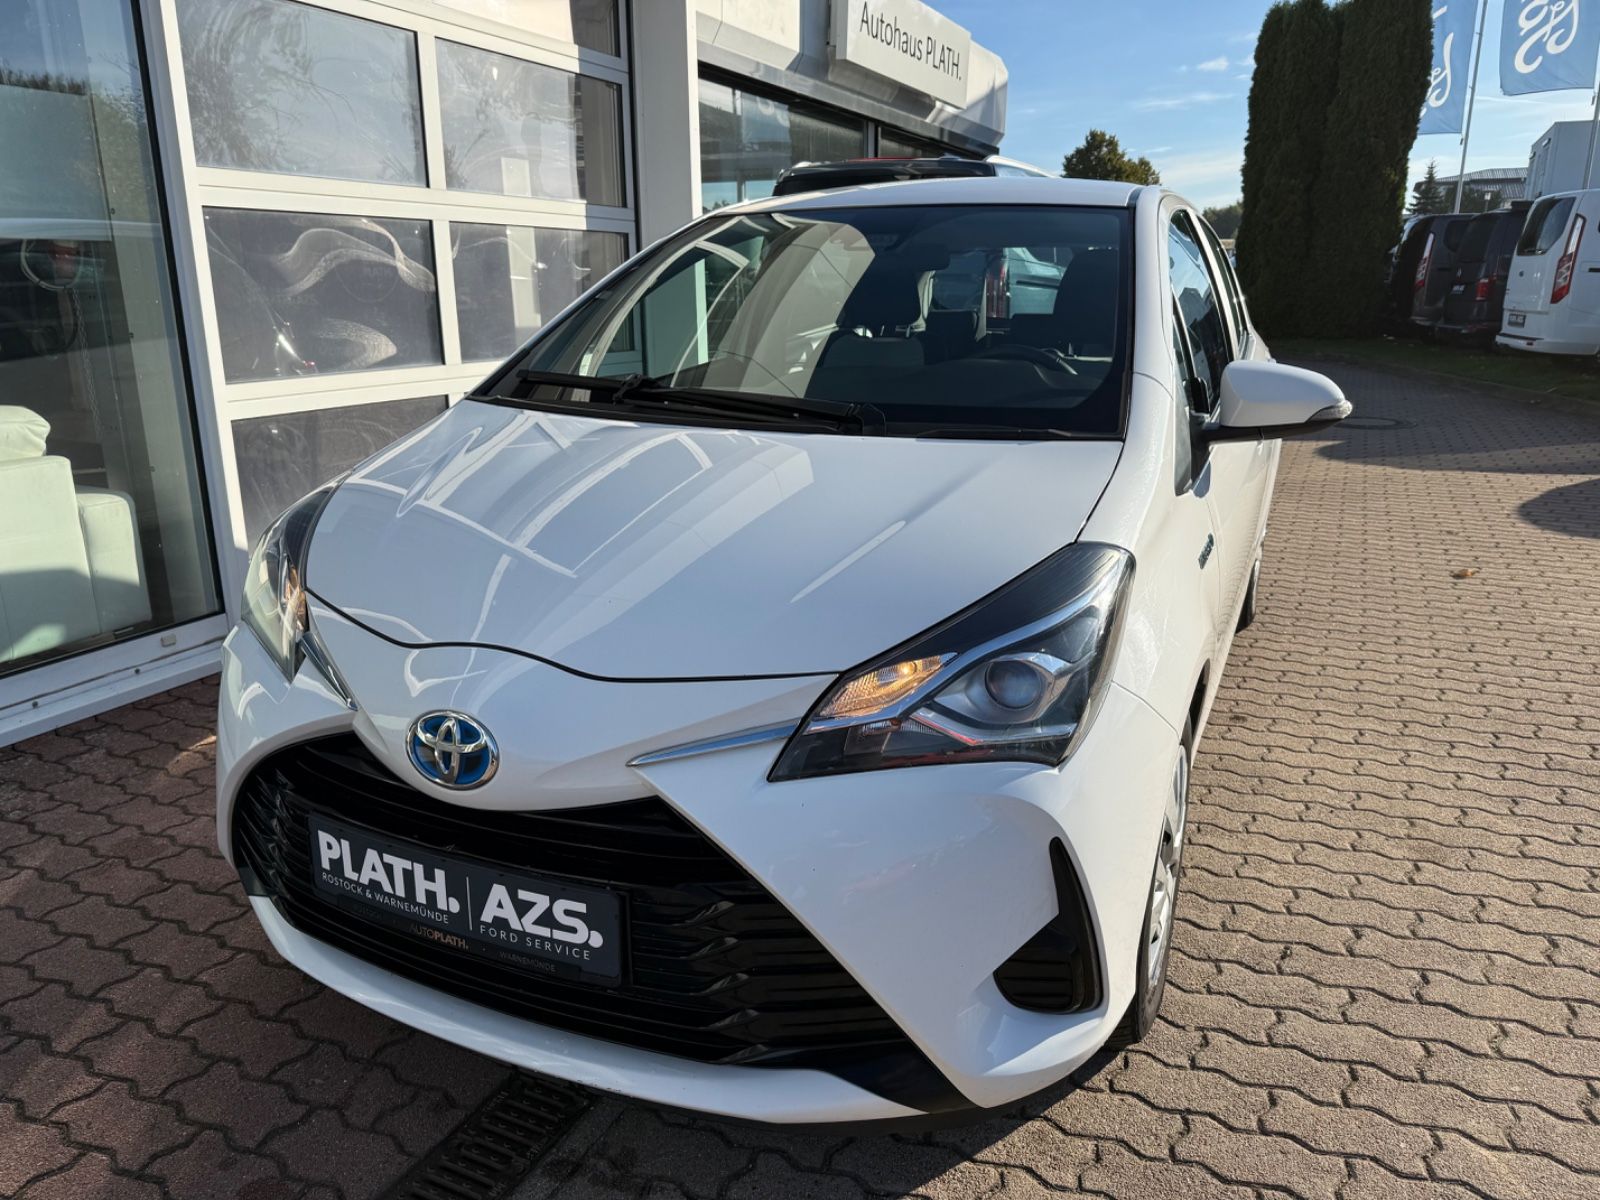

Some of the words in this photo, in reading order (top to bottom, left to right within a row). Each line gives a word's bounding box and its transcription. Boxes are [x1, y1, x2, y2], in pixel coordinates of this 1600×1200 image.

[860, 1, 923, 61] Autohaus
[926, 36, 962, 81] PLATH.
[317, 829, 461, 914] PLATH.
[321, 872, 364, 897] ROSTOCK
[365, 888, 373, 899] &
[374, 891, 449, 925] WARNEMÜNDE
[480, 883, 604, 949] AZS.
[480, 925, 518, 944] FORD
[526, 940, 591, 961] SERVICE
